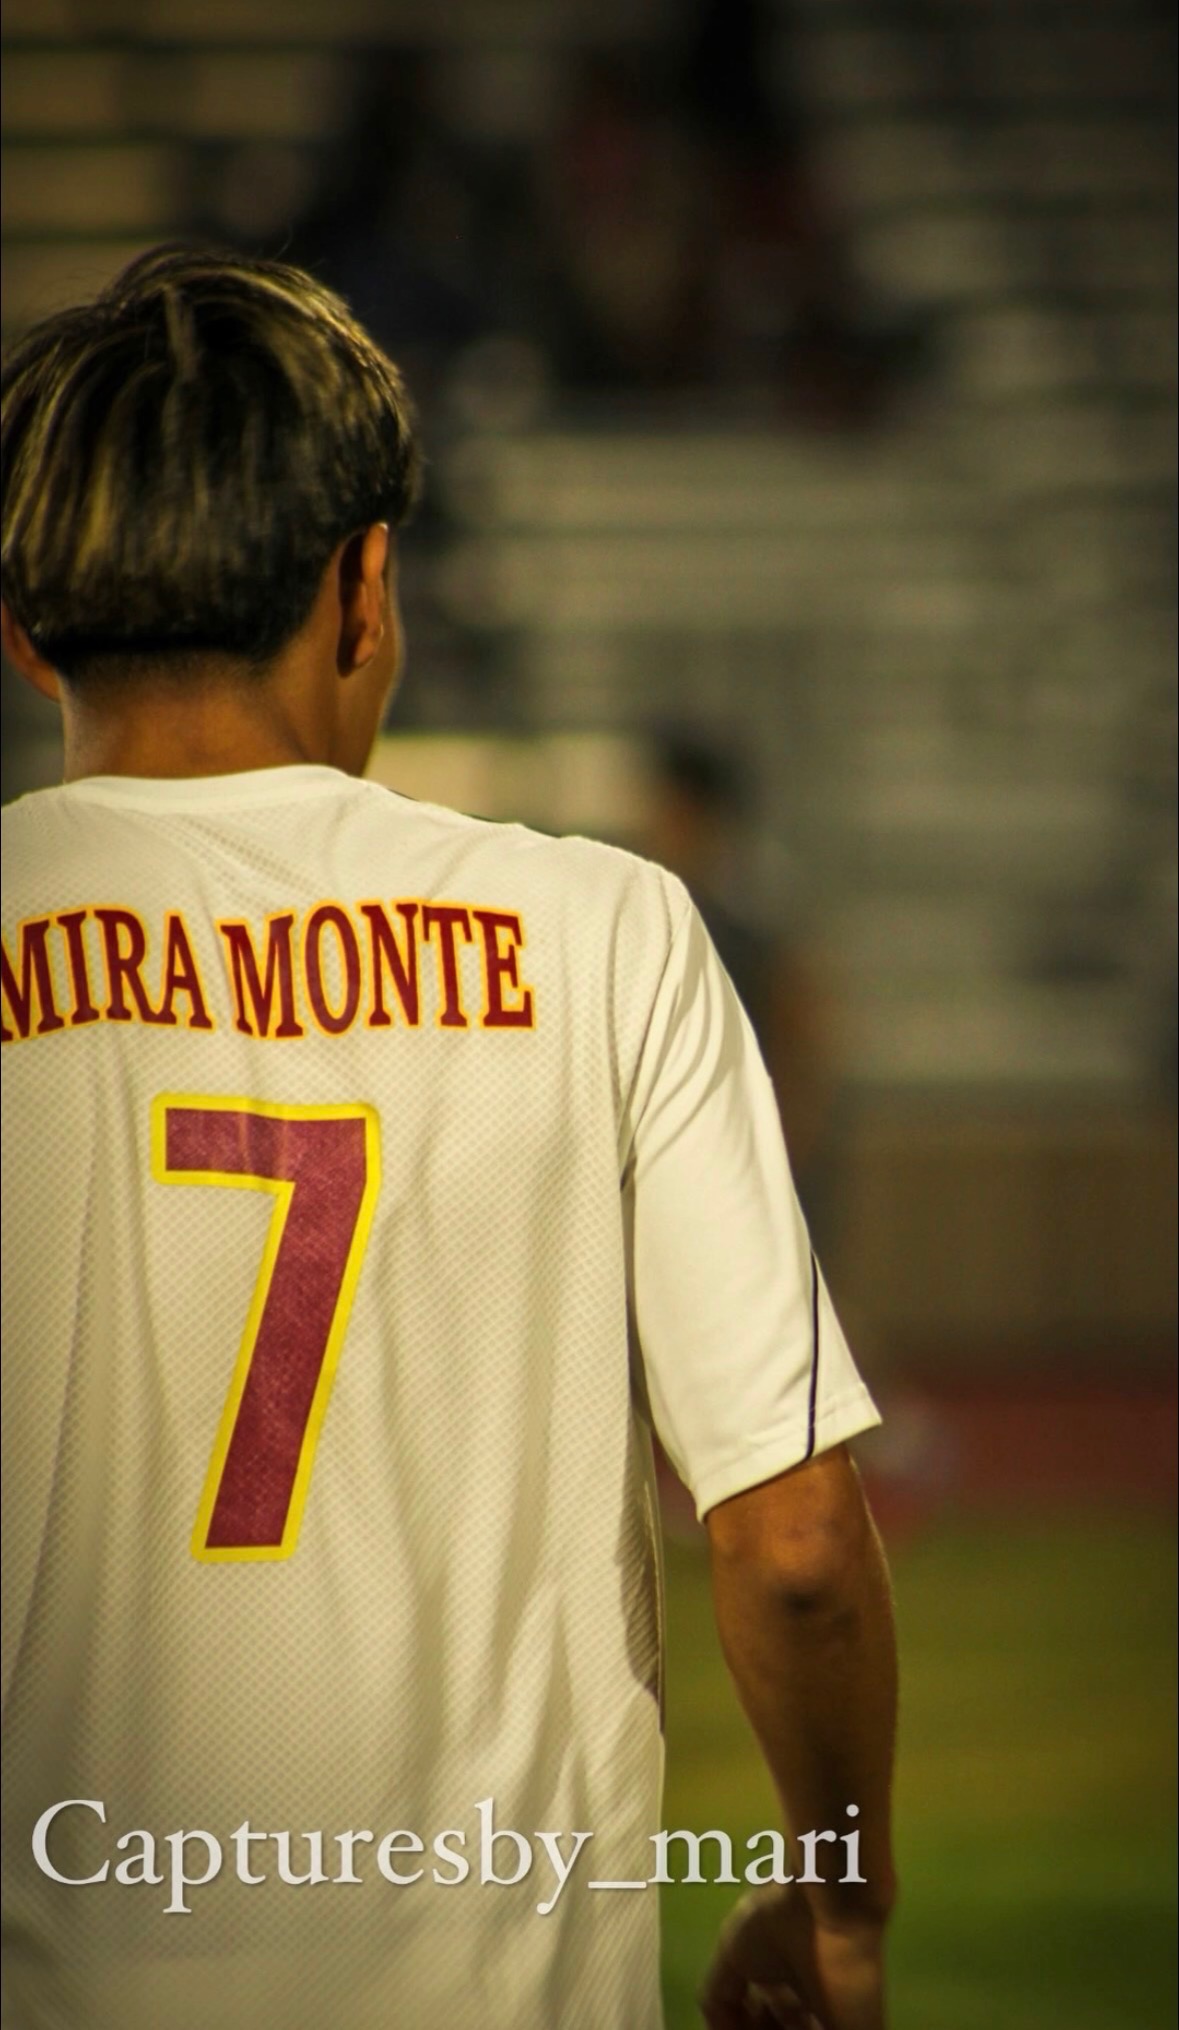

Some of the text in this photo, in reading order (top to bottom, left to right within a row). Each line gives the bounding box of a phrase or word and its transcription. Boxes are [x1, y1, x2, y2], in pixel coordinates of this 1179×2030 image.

[0, 898, 536, 1043] MIRA MONTE
[151, 1092, 382, 1563] 7
